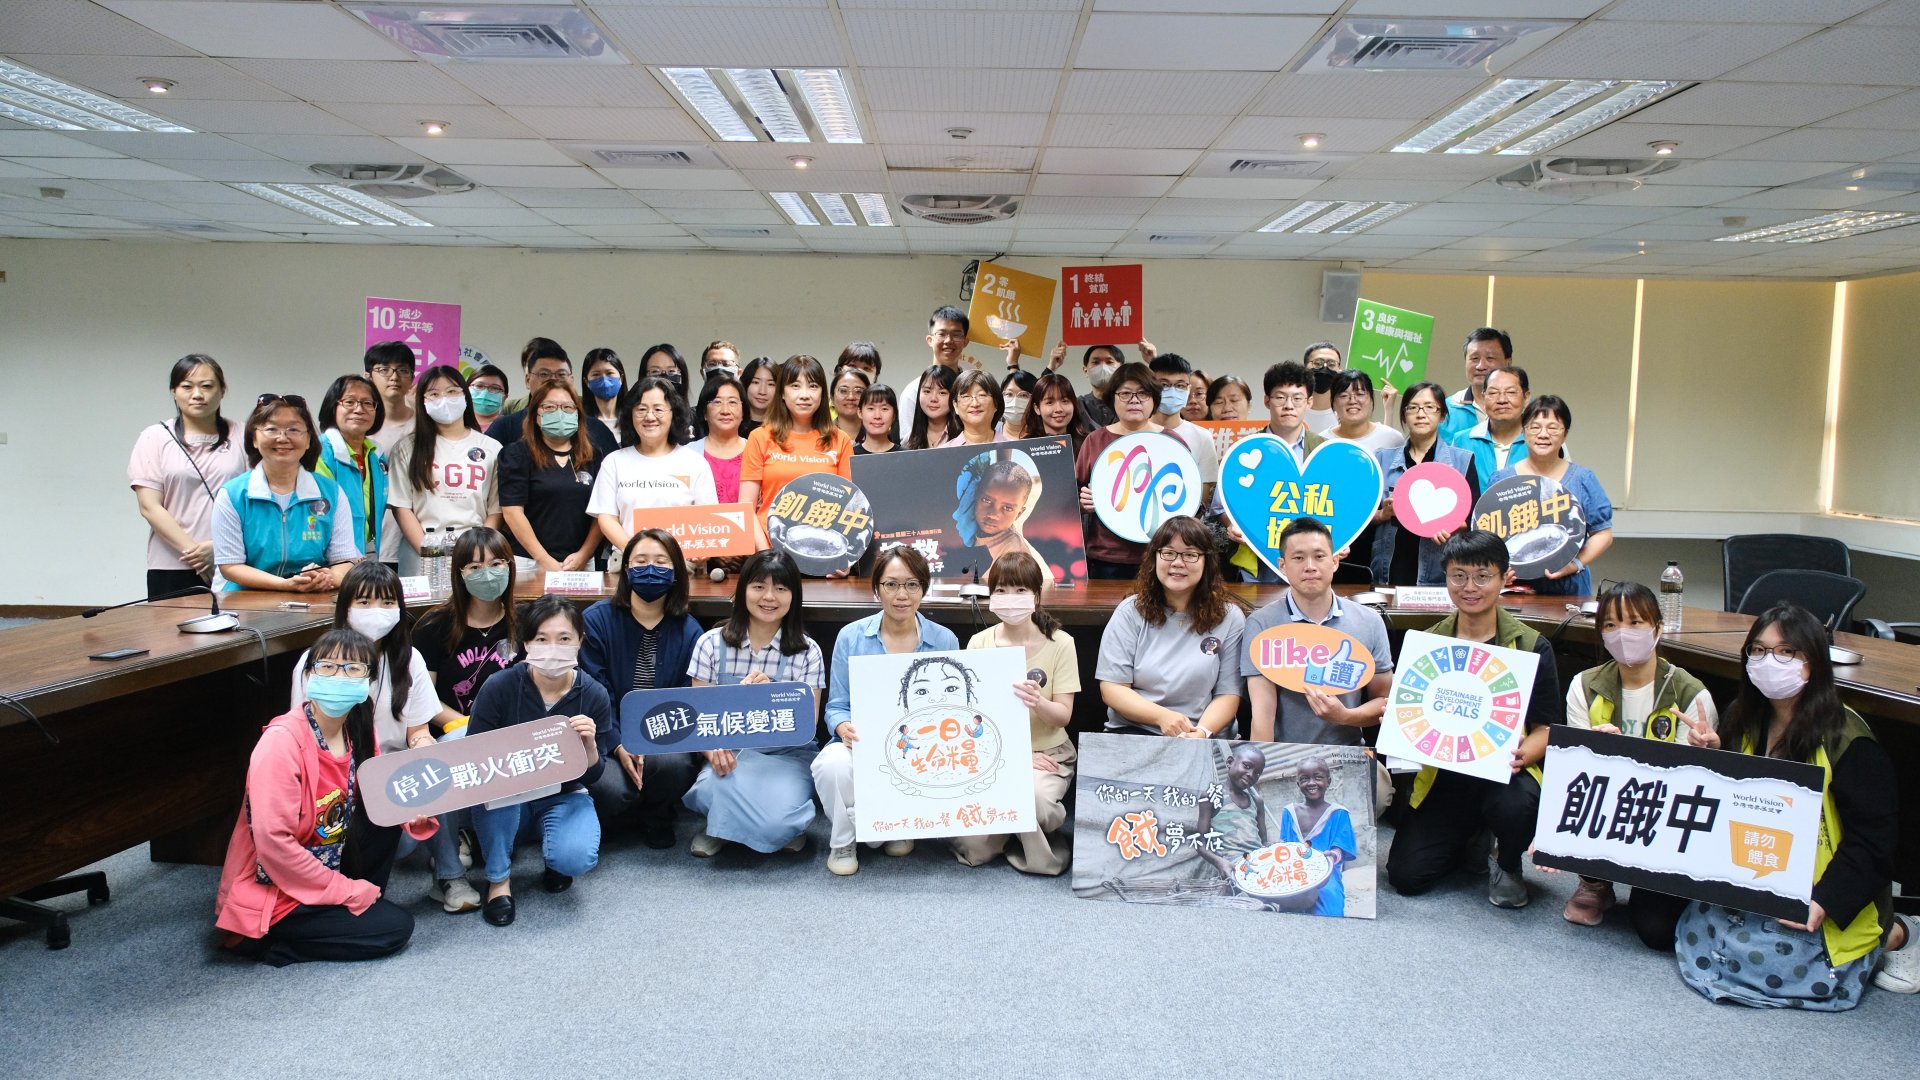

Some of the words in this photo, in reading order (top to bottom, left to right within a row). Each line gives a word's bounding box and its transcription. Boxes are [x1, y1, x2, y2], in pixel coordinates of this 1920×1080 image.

[981, 273, 997, 295] 2
[998, 276, 1009, 288] 零
[1069, 274, 1079, 294] 1
[1084, 272, 1104, 283] 終結
[996, 289, 1017, 301] 飢餓
[1088, 283, 1109, 294] 貧窮
[369, 306, 396, 330] 10
[398, 308, 423, 320] 減少
[1361, 309, 1375, 331] 3
[1377, 312, 1398, 325] 良好
[398, 320, 434, 333] 不平等
[1375, 323, 1423, 344] 健康與福祉
[769, 452, 797, 463] World
[799, 455, 829, 463] Vision
[617, 479, 646, 489] World
[648, 479, 679, 489] Vision
[1496, 487, 1514, 497] World
[1268, 480, 1335, 517] 公私
[773, 490, 870, 536] 飢餓中
[1475, 491, 1571, 540] 飢餓中
[688, 522, 731, 536] Vision
[1260, 637, 1331, 668] like
[1330, 660, 1355, 686] 讚
[1435, 694, 1482, 709] DEVELOPMENT
[1436, 687, 1484, 703] SUSTAINABLE
[1433, 700, 1480, 720] GOALS
[1095, 784, 1157, 804] 你的一天
[1732, 792, 1758, 803] World
[1759, 797, 1784, 808] Vision
[1556, 771, 1721, 854] 飢餓中
[1743, 830, 1776, 849] 請勿
[1747, 849, 1780, 869] 餵食
